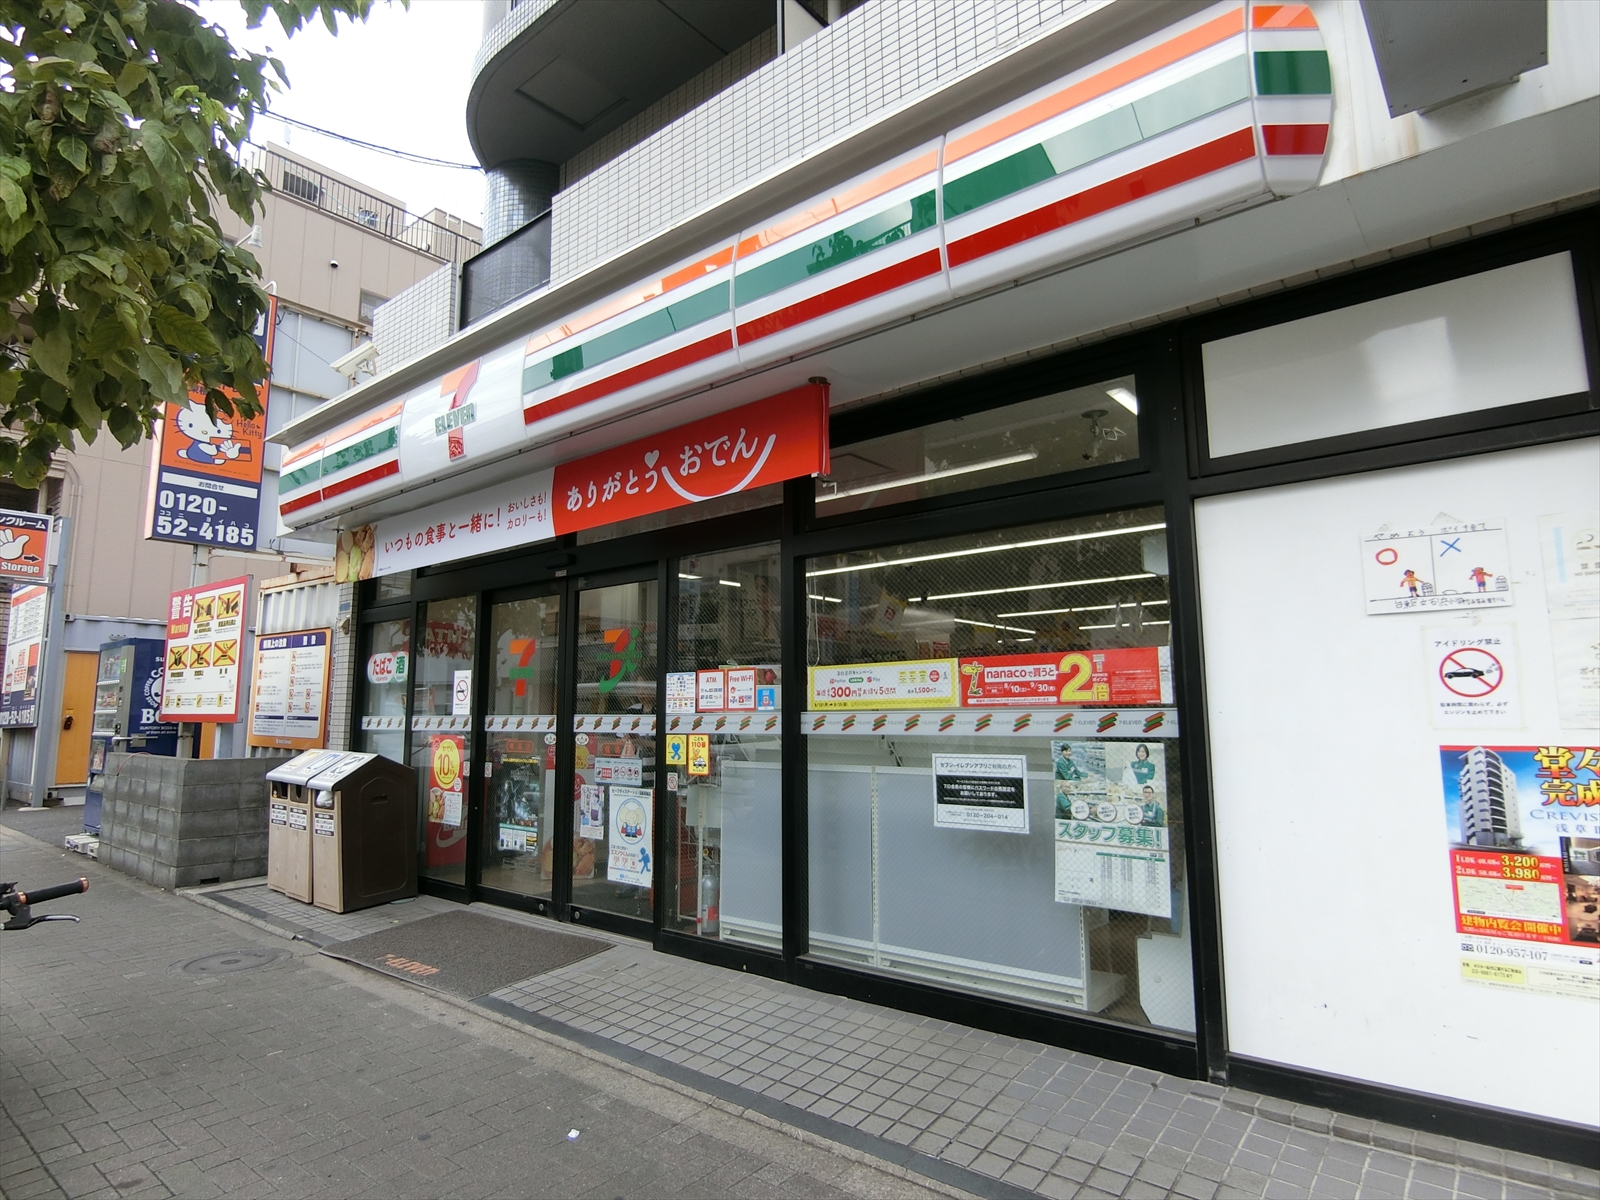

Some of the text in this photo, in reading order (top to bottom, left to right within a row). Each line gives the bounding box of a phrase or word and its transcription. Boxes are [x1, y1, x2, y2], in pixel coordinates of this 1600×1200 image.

[237, 419, 255, 429] Hello
[243, 428, 262, 439] Kitty
[567, 428, 758, 512] ありがとう おでん
[507, 491, 547, 513] おいしさも!
[507, 509, 547, 530] カロリーも!
[157, 515, 254, 546] 52-4185
[385, 508, 501, 553] いつもの食事と一緒に!
[1, 562, 40, 573] Storage
[1434, 638, 1501, 647] アイドリング禁止
[372, 656, 406, 676] たばこ 酒
[986, 668, 1055, 679] nanacoで買うと
[1059, 653, 1093, 702] 2
[966, 812, 1008, 820] 0120-204-014
[1059, 822, 1162, 848] スタッフ募集!
[1501, 855, 1539, 868] 3,200
[1502, 867, 1540, 879] 3,980
[1476, 943, 1549, 961] 0120-957-107
